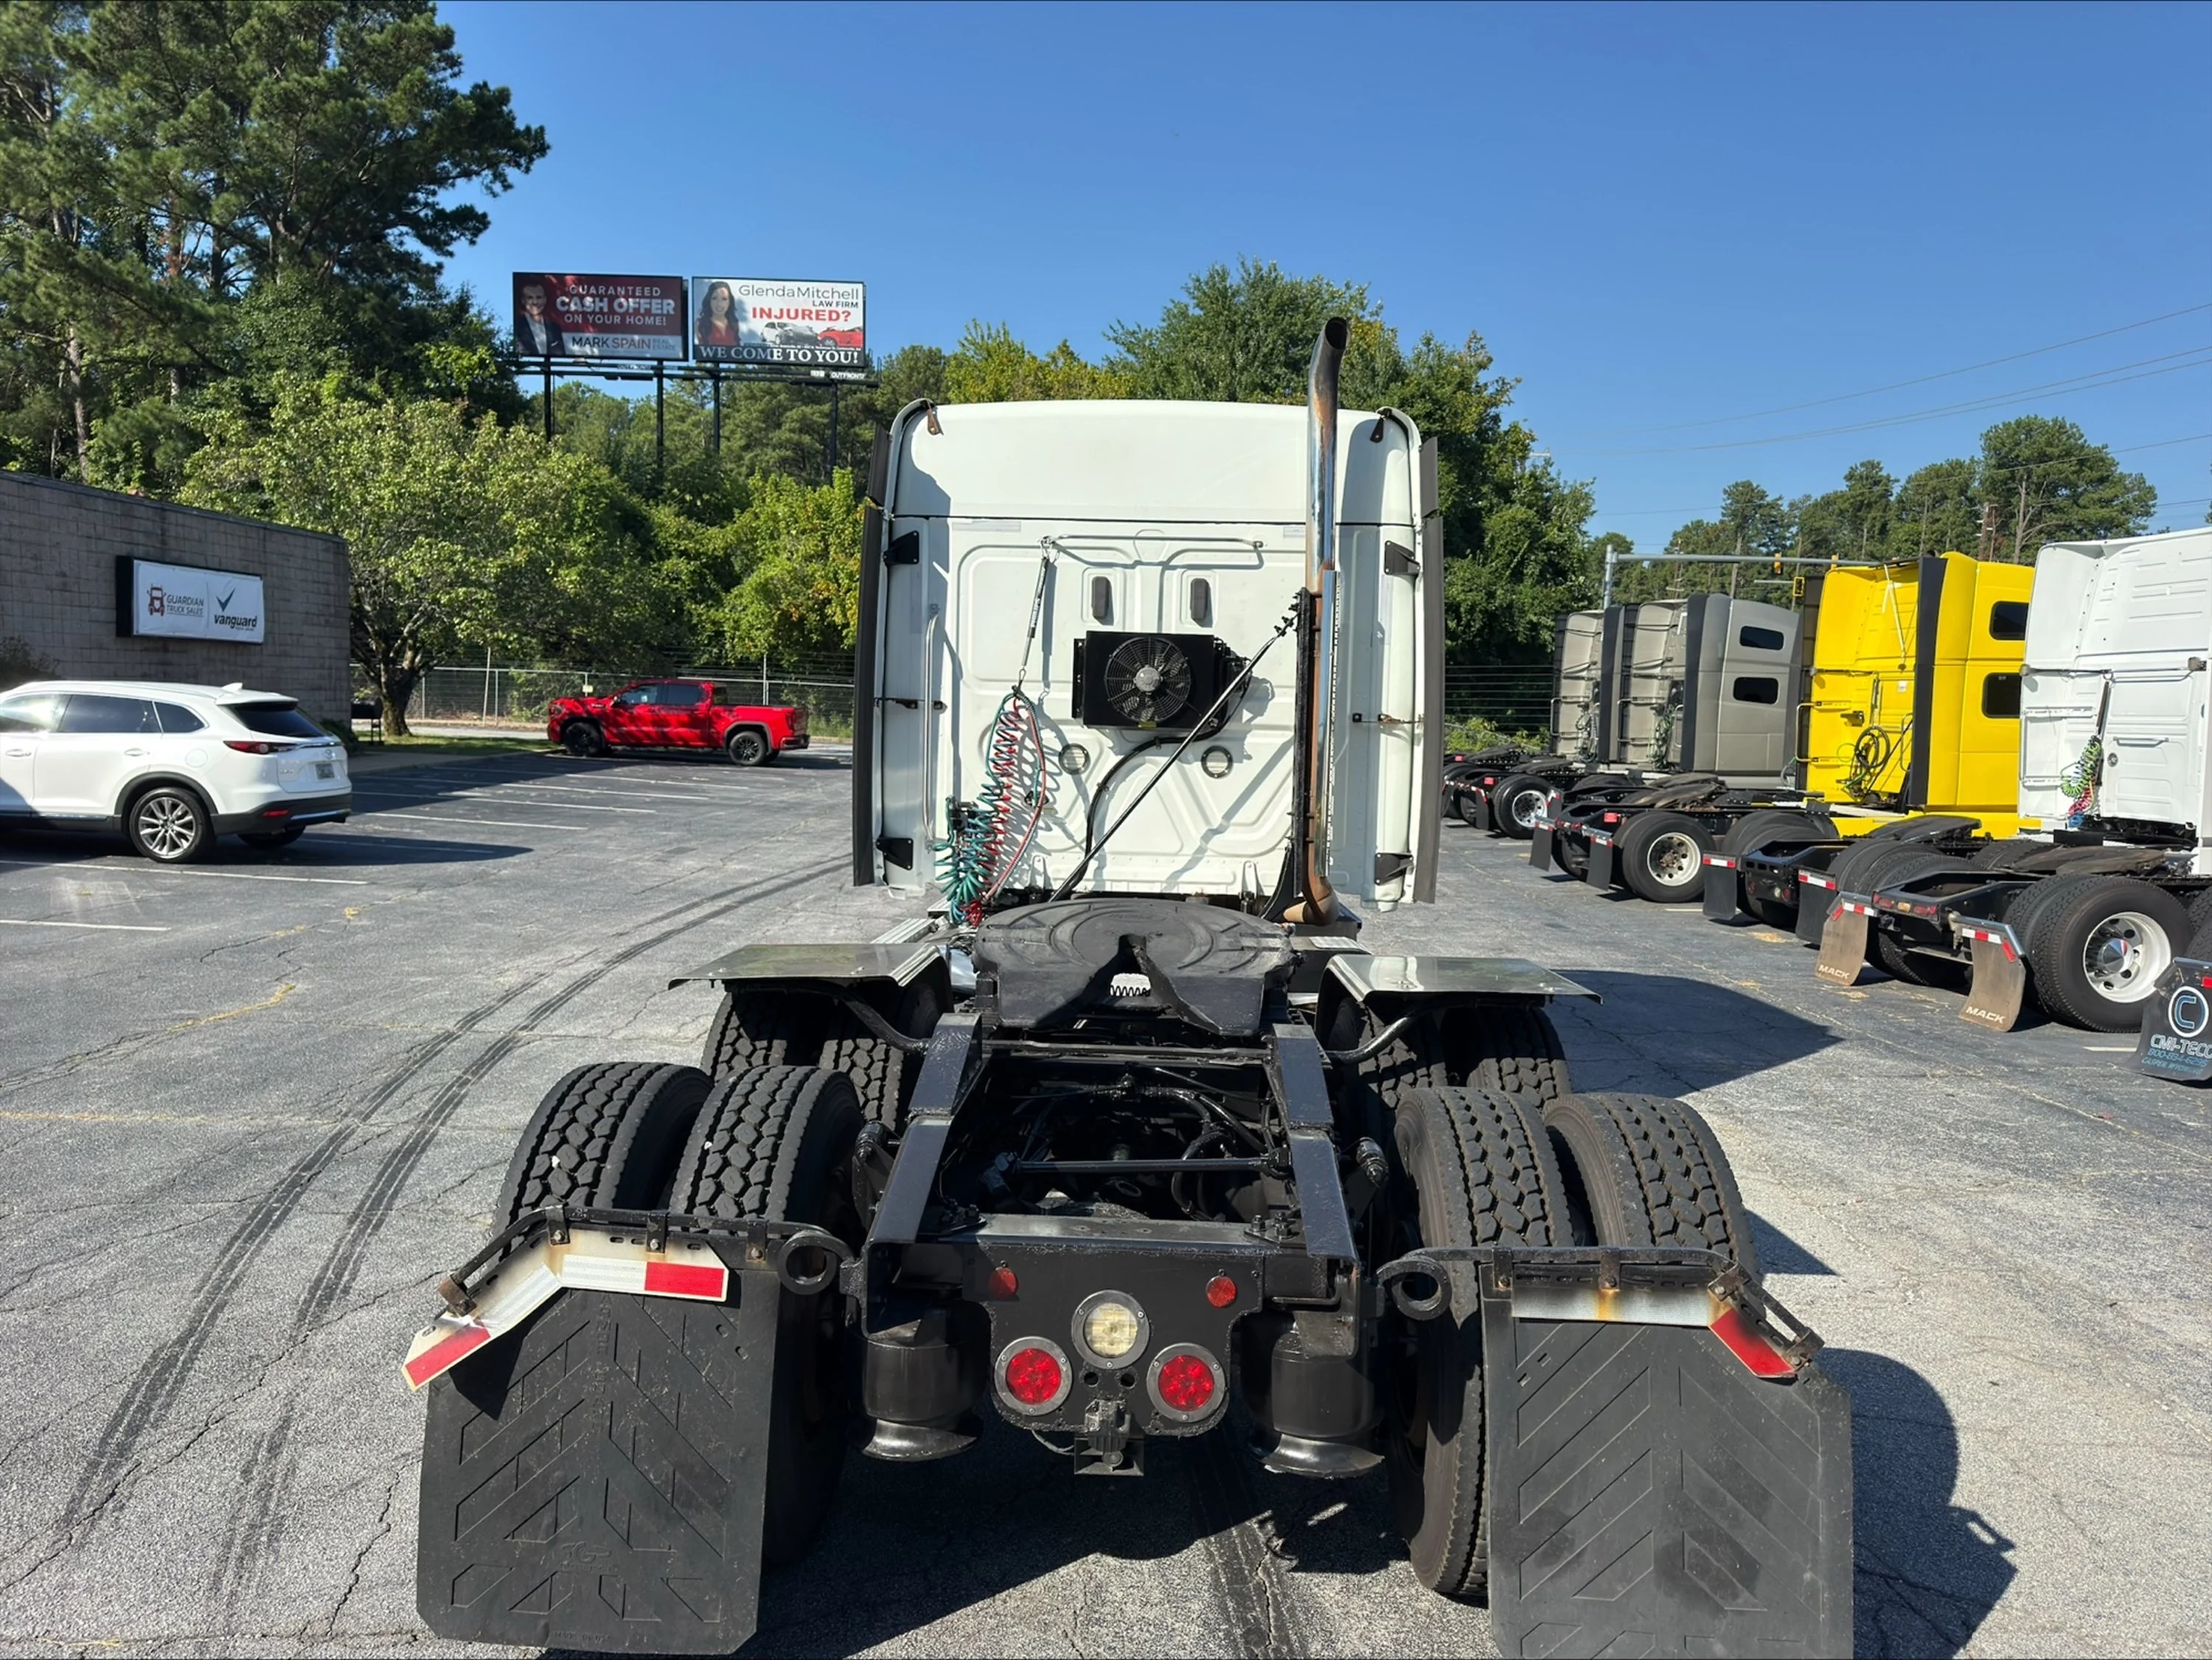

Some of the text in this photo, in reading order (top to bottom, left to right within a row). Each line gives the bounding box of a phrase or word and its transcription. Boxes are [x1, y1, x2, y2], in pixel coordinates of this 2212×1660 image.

[569, 285, 661, 296] GUARANTEED
[556, 296, 675, 315] CASH OFFER
[564, 314, 667, 325] ON YOUR HOME!
[752, 307, 851, 321] INJURED?
[572, 336, 651, 349] MARK SPAIN
[700, 346, 858, 363] WE COME TO YOU!
[167, 594, 204, 606] GUARDIAN
[167, 605, 204, 615] TRUCK SALES
[214, 615, 257, 629] vanguard
[1818, 964, 1851, 980] MACK
[1966, 1006, 2006, 1024] MACK
[2175, 995, 2197, 1029] C
